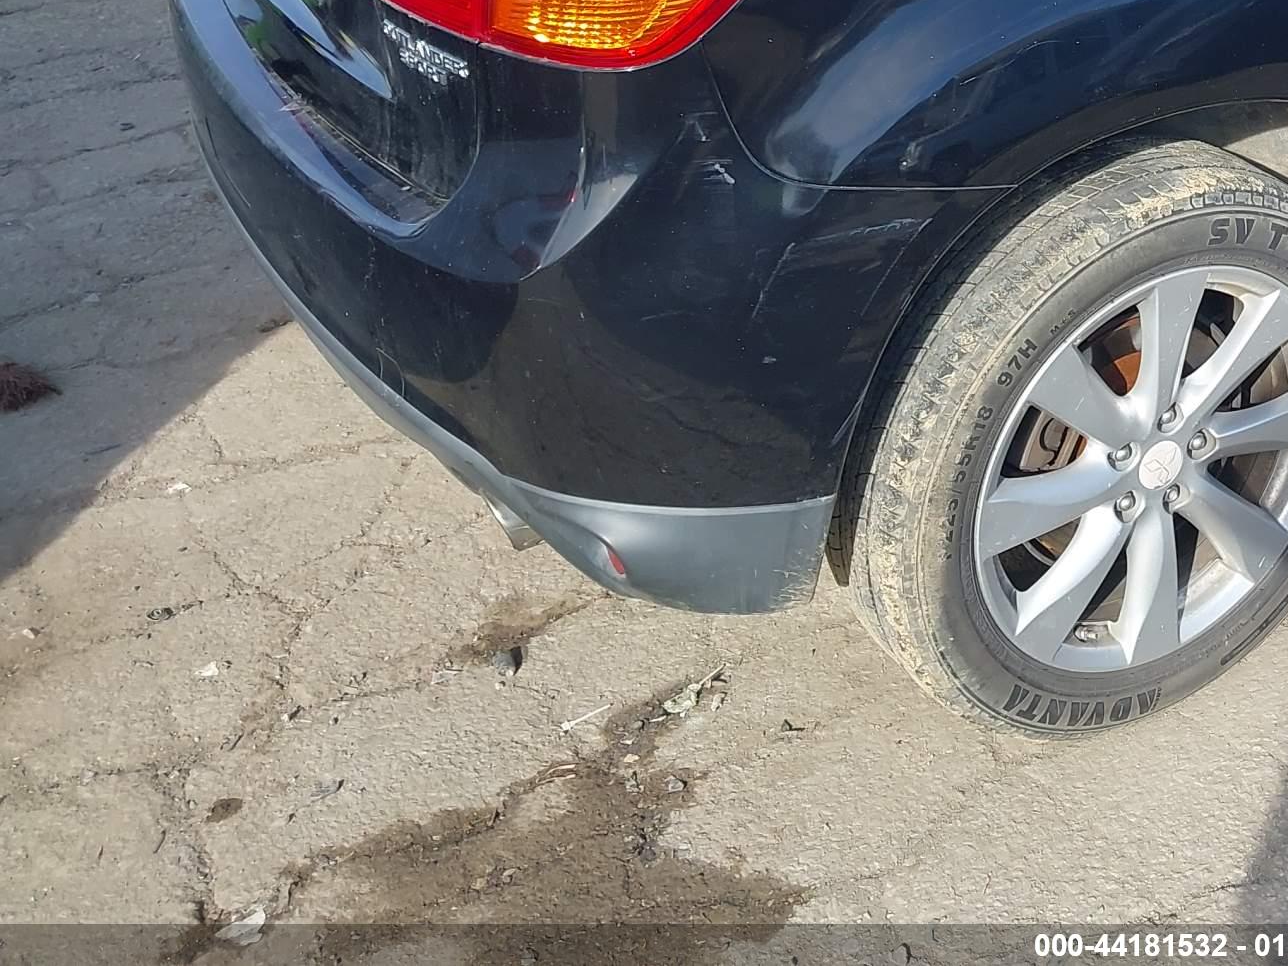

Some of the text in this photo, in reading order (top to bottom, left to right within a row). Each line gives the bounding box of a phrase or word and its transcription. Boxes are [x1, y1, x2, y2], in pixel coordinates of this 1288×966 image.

[1208, 218, 1256, 245] SV
[997, 338, 1038, 387] 97H
[1002, 684, 1157, 727] ADVANTA
